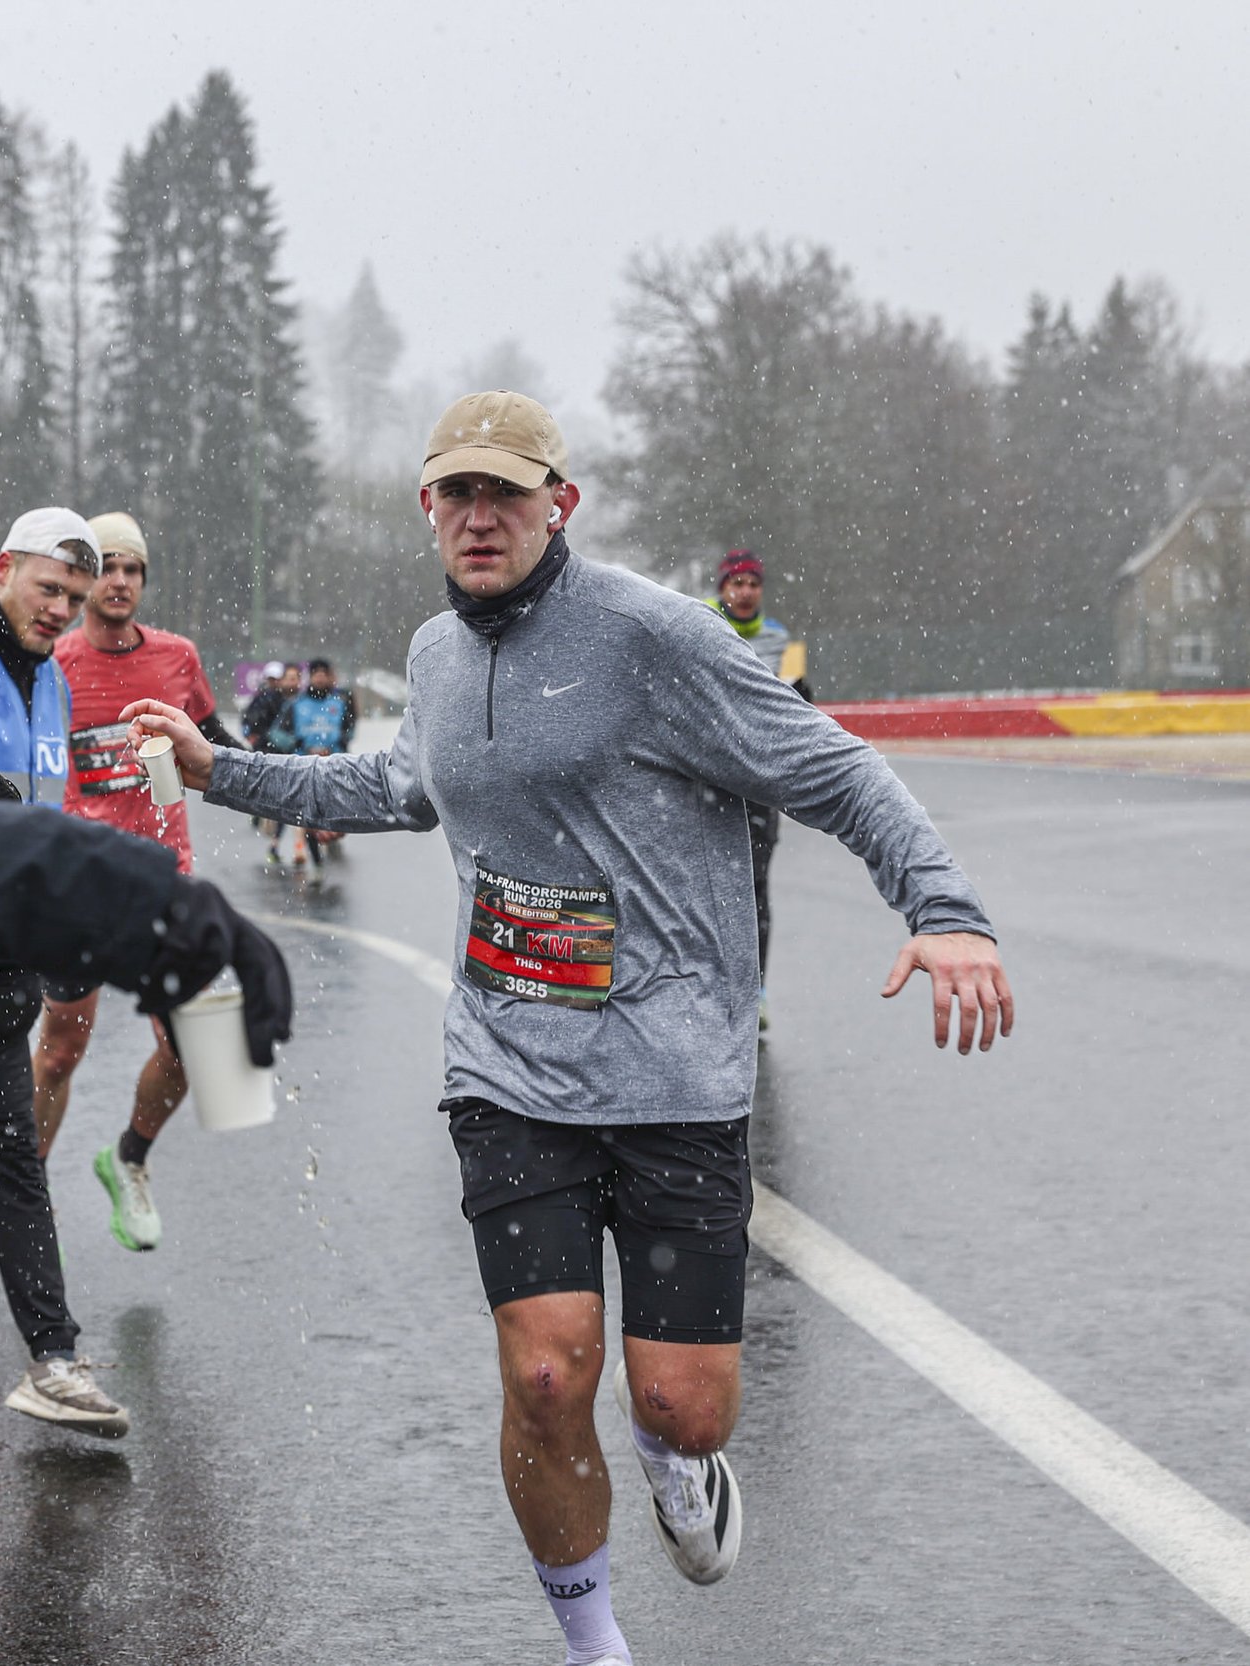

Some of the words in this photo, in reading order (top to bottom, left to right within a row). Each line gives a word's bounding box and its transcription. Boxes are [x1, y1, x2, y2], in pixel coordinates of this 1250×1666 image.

[504, 889, 527, 905] RUN
[530, 896, 562, 909] 2026
[522, 908, 556, 919] EDITION
[492, 921, 514, 949] 21
[526, 932, 574, 958] KM
[505, 975, 548, 998] 3625
